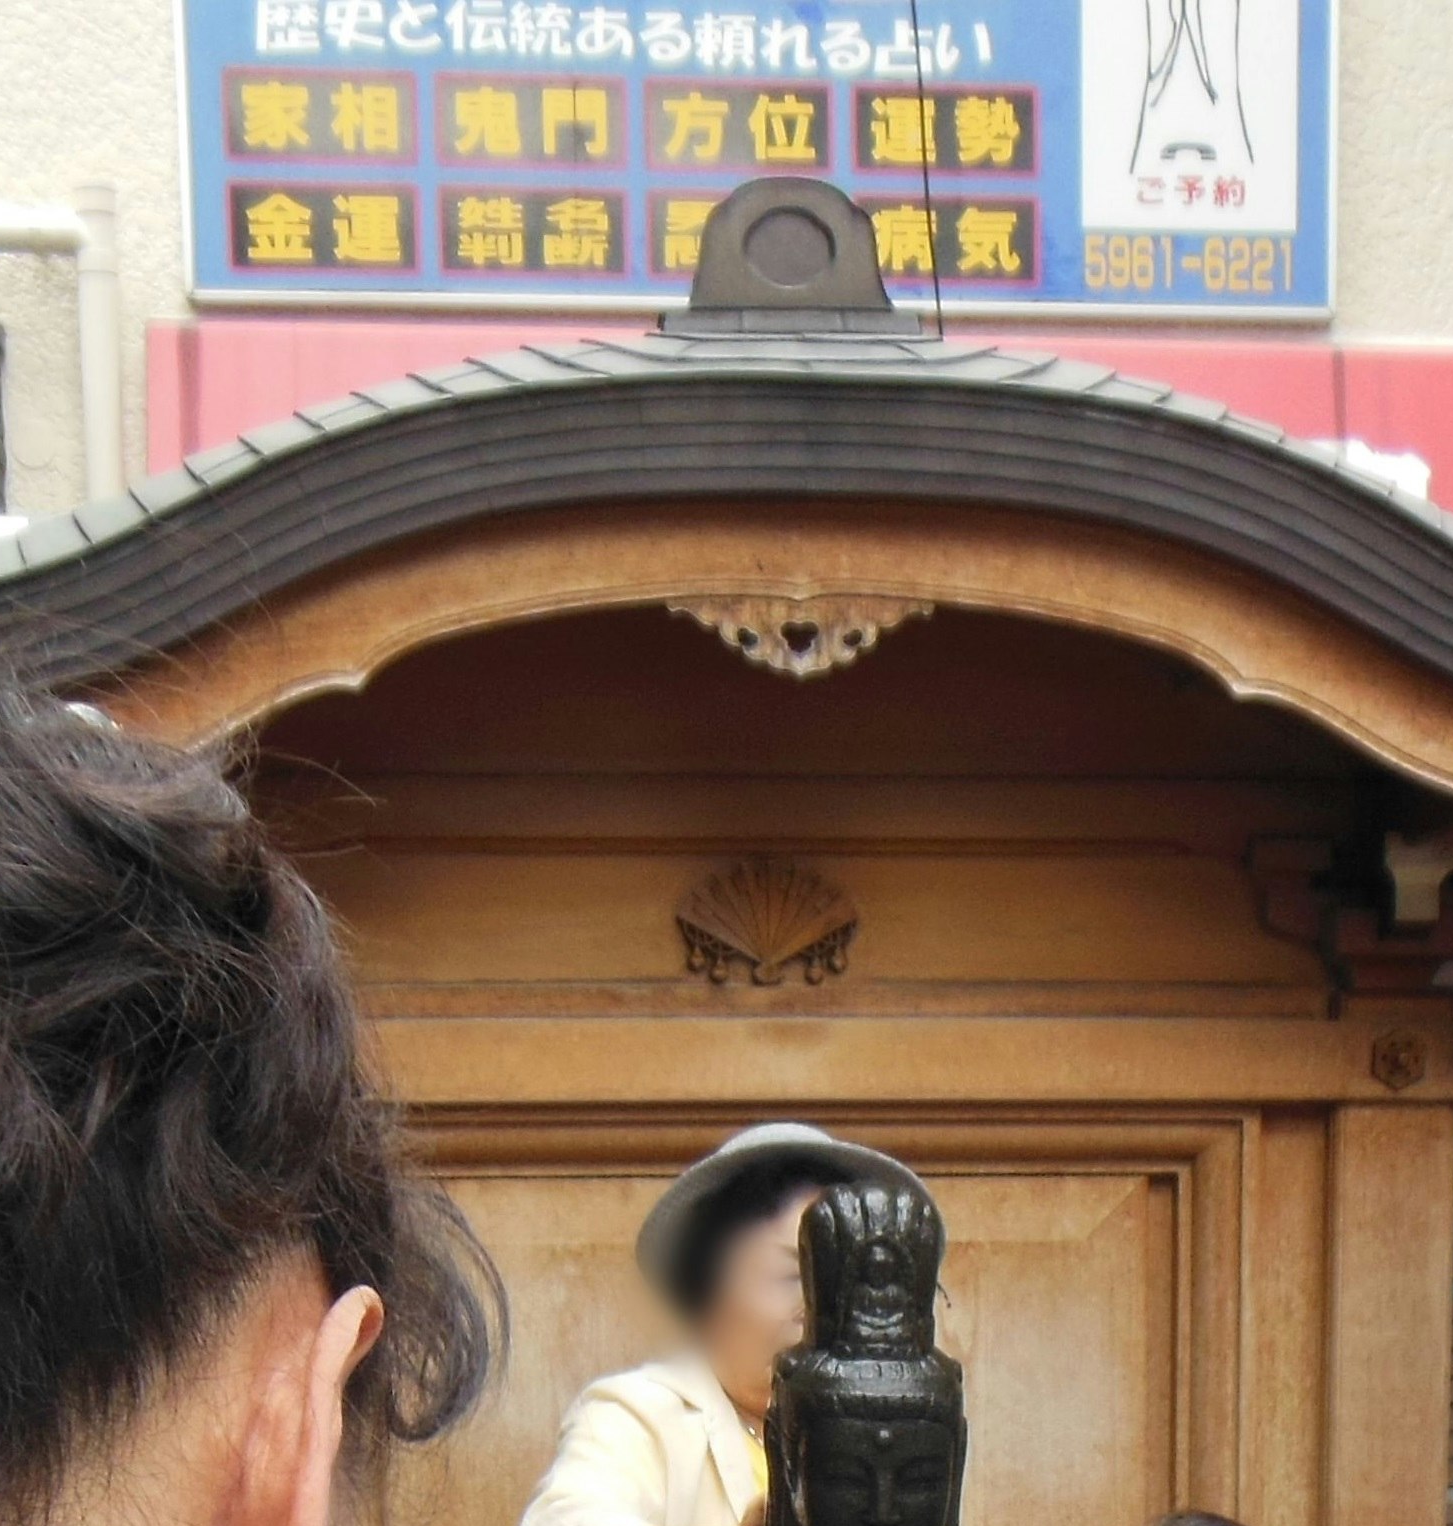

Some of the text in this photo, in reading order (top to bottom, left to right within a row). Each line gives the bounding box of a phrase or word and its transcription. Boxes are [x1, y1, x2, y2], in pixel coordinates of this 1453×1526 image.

[254, 0, 993, 73] 歴史と伝統ある頼れる占い
[241, 81, 1020, 162] 家相 鬼門 方位 運勢
[1136, 174, 1245, 208] ご予約
[245, 191, 402, 263] 金運
[871, 205, 1021, 272] 病気
[1083, 234, 1293, 292] 5961-6221
